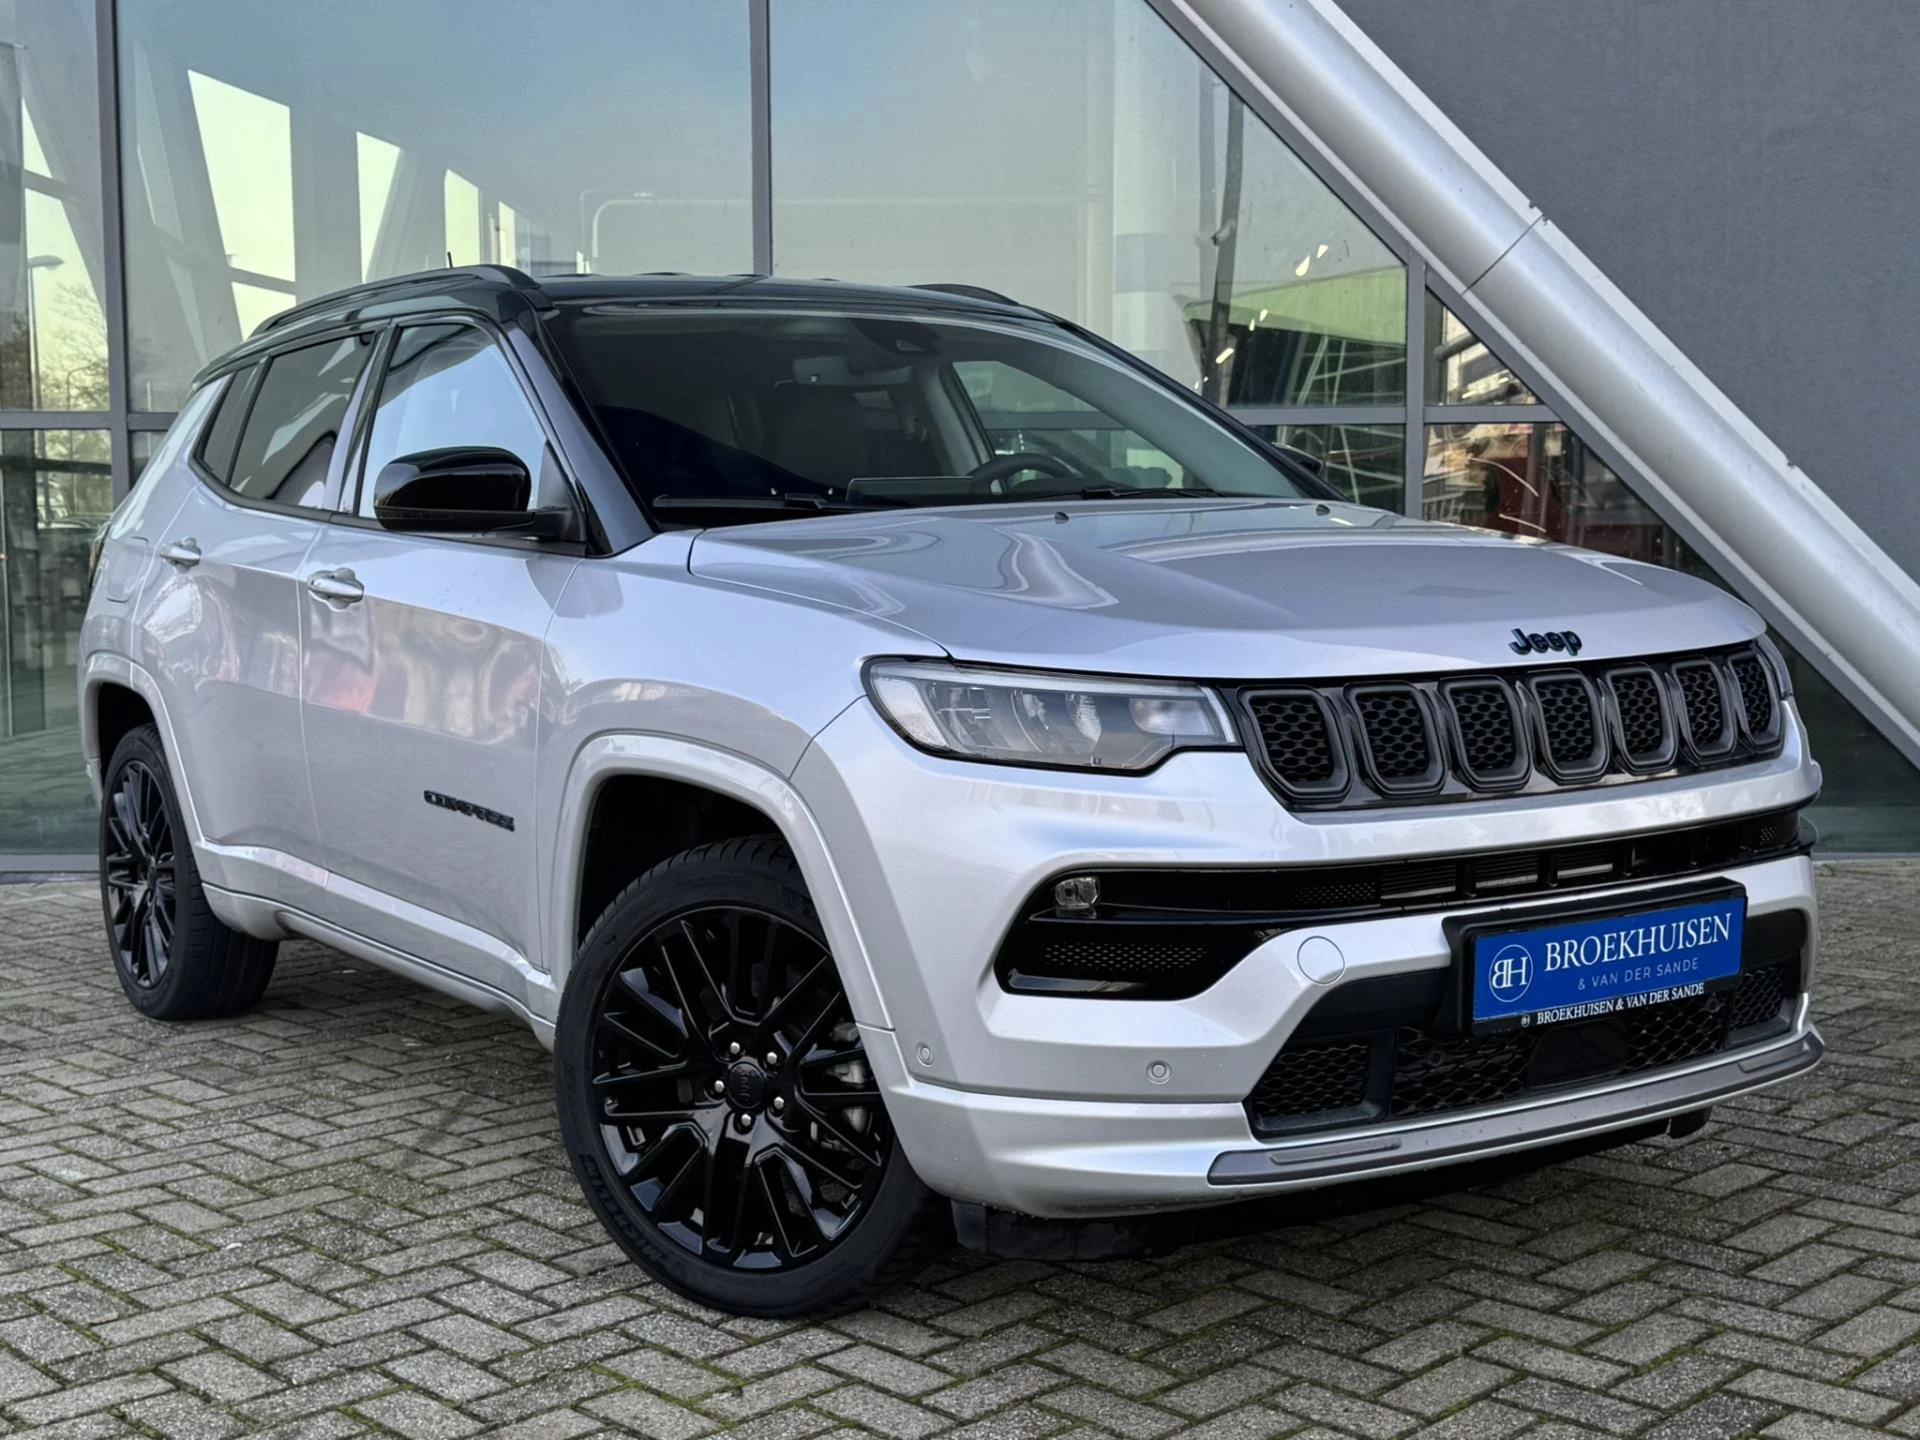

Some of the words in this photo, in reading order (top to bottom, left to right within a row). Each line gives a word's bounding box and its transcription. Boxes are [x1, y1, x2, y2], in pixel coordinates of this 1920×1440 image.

[1508, 628, 1582, 656] Jeep
[1545, 912, 1733, 972] BROEKHUISEN
[1577, 977, 1586, 991] &
[1591, 972, 1618, 989] VAN
[1624, 966, 1651, 983] DER
[1656, 956, 1700, 976] SANDE
[1536, 1002, 1614, 1025] BROEKHUISEN
[1615, 998, 1624, 1011] &
[1626, 994, 1648, 1009] VAN
[1649, 990, 1670, 1005] DER
[1671, 982, 1705, 1003] SANDE
